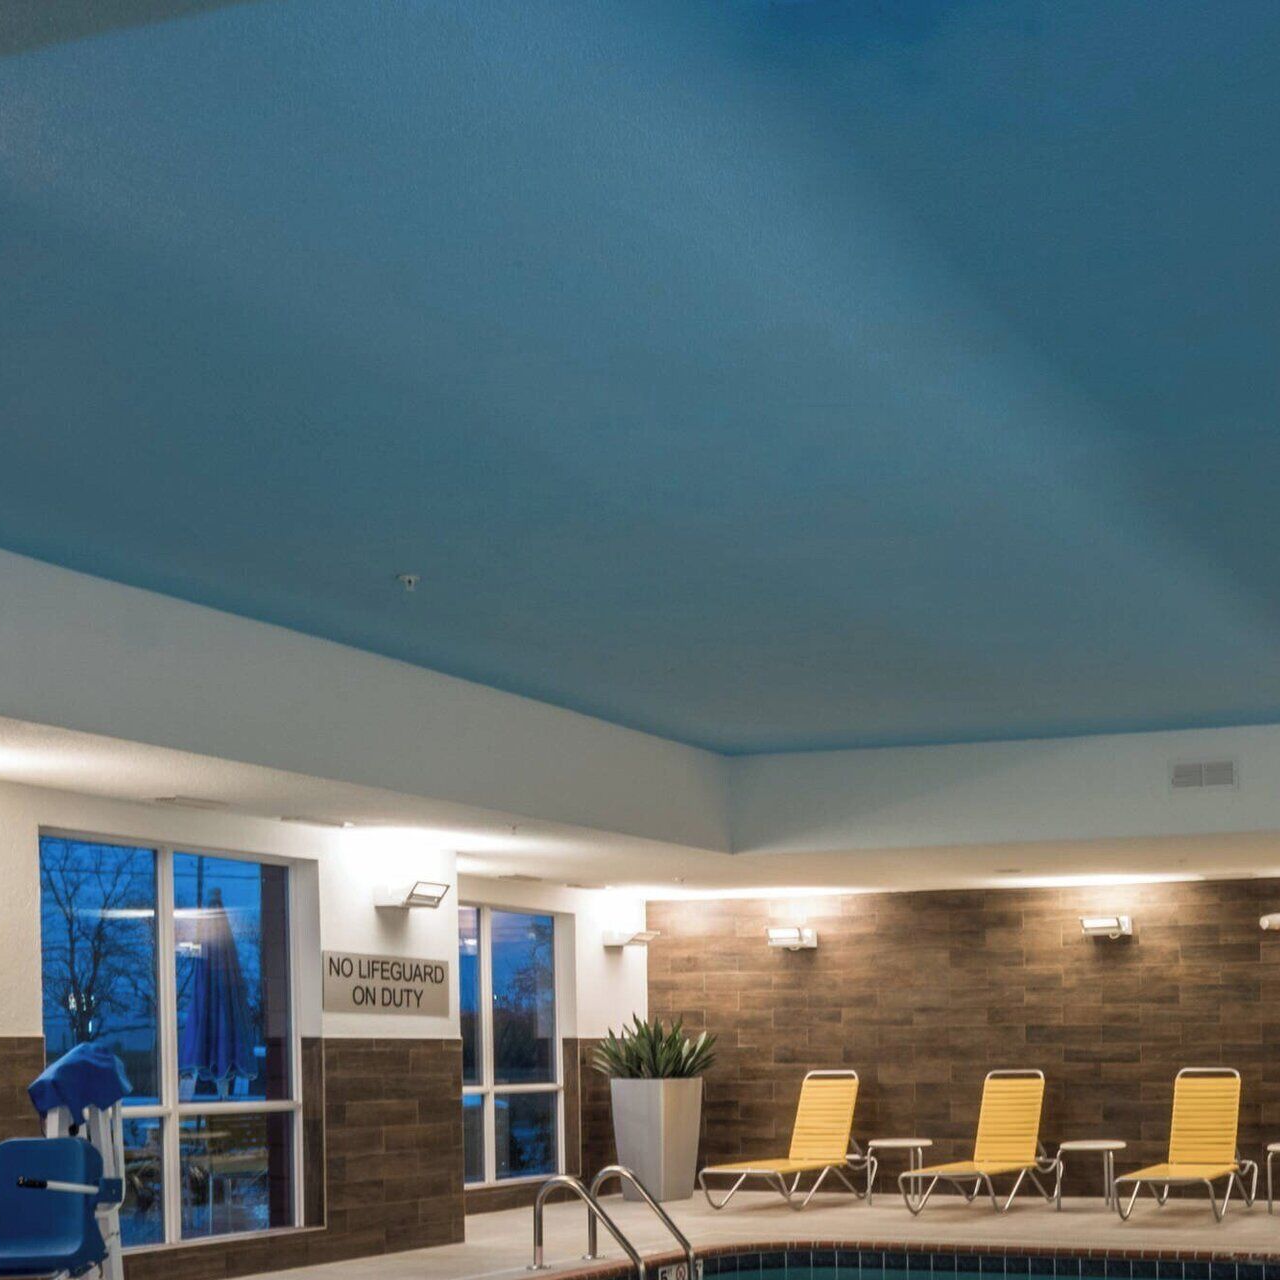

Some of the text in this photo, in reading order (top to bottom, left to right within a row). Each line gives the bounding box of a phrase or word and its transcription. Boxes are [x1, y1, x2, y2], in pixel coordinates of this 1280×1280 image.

[329, 957, 445, 984] NO LIFEGUARD
[352, 985, 424, 1008] ON DUTY
